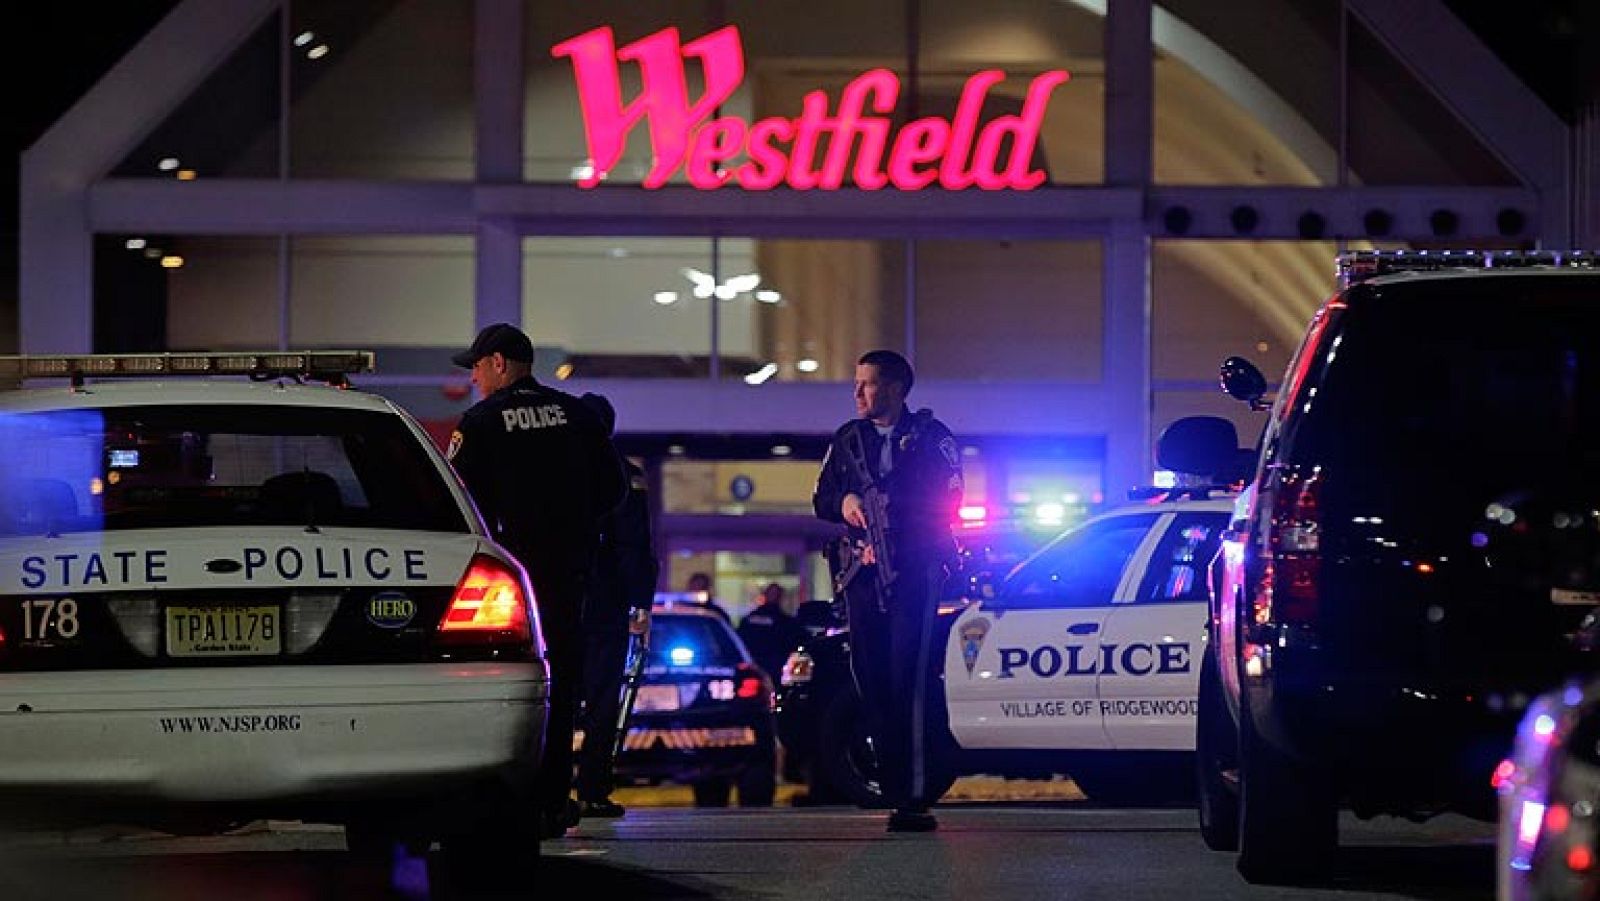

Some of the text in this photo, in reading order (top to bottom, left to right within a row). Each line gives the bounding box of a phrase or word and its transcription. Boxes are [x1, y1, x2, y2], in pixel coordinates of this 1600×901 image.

[551, 24, 1070, 191] Westfield
[502, 404, 567, 432] POLICE
[21, 546, 428, 588] STATE POLICE
[21, 599, 80, 639] 178
[370, 600, 414, 616] HERO
[998, 643, 1191, 678] POLICE
[160, 714, 302, 733] WWW.NJSP.ORG
[1000, 701, 1066, 717] VILLAGE
[1072, 700, 1093, 716] OF
